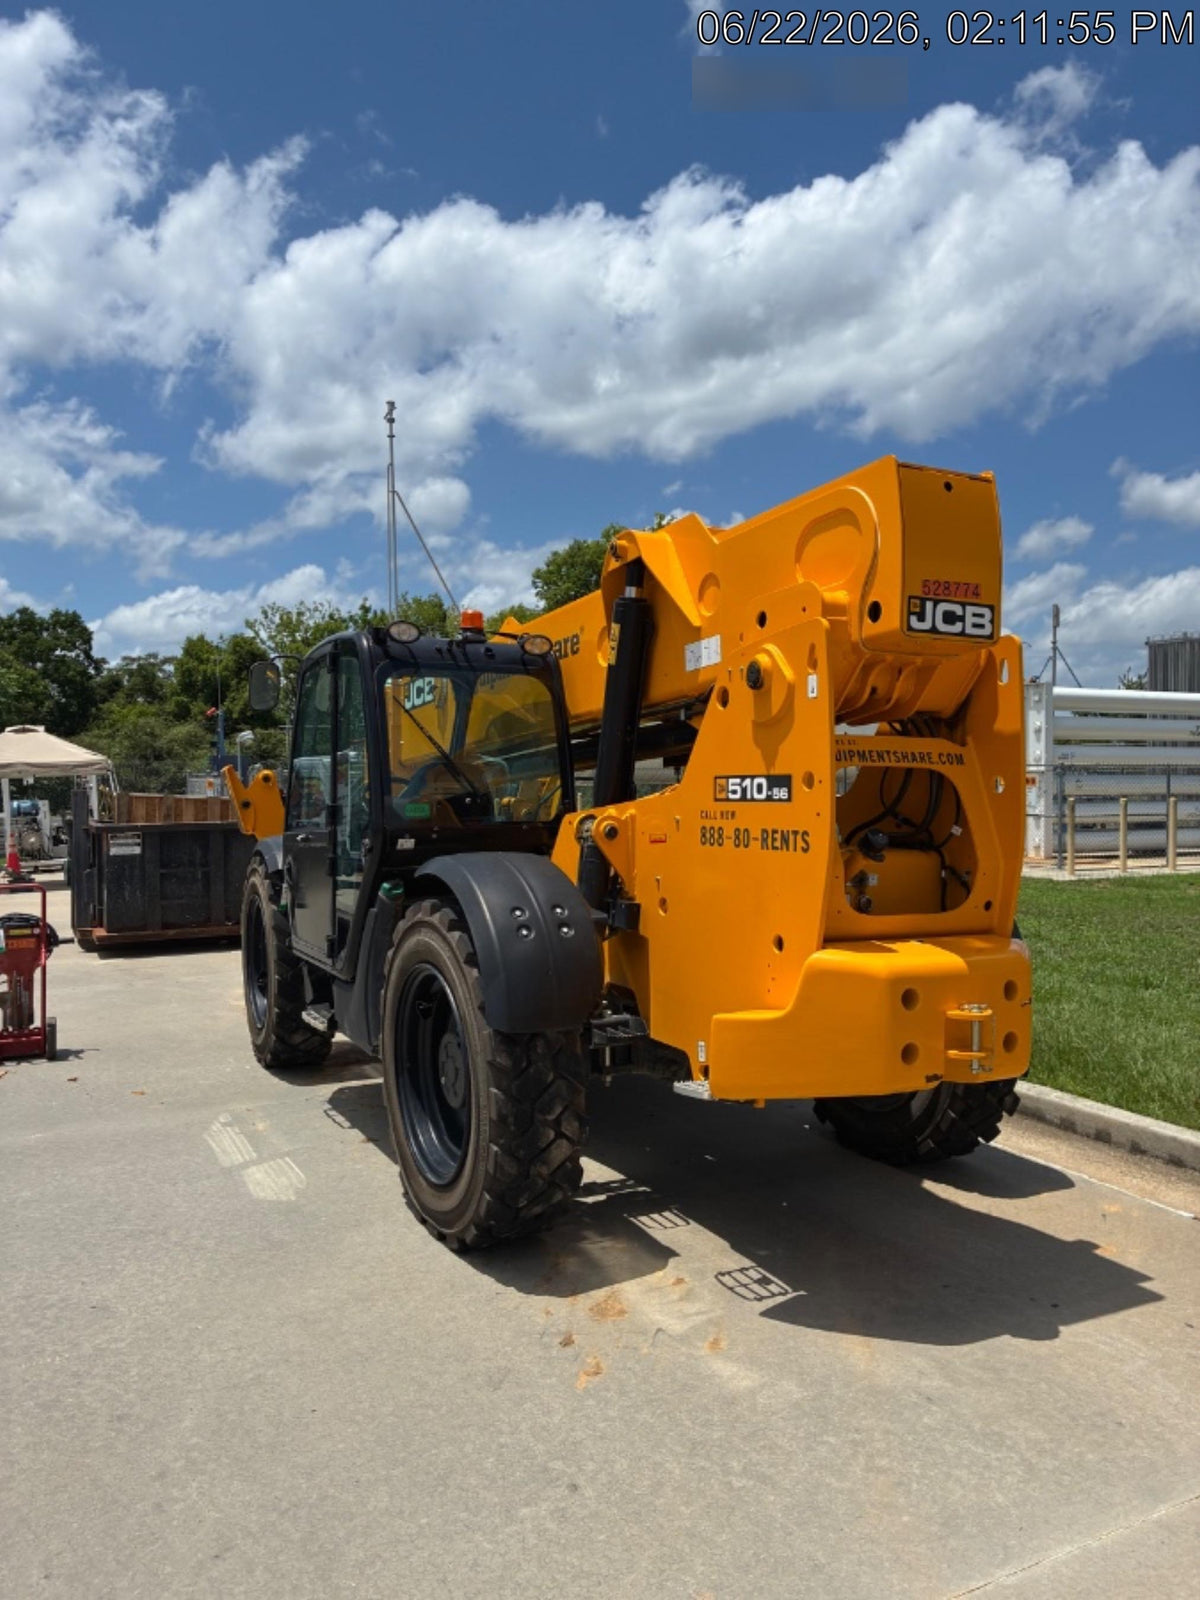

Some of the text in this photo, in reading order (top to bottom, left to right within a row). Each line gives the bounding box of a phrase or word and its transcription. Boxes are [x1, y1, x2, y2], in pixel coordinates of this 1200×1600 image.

[923, 579, 981, 597] 528774
[909, 600, 993, 636] JCB
[404, 677, 435, 711] JCB
[700, 810, 717, 820] CALL
[700, 825, 810, 854] 888-80-RENTS
